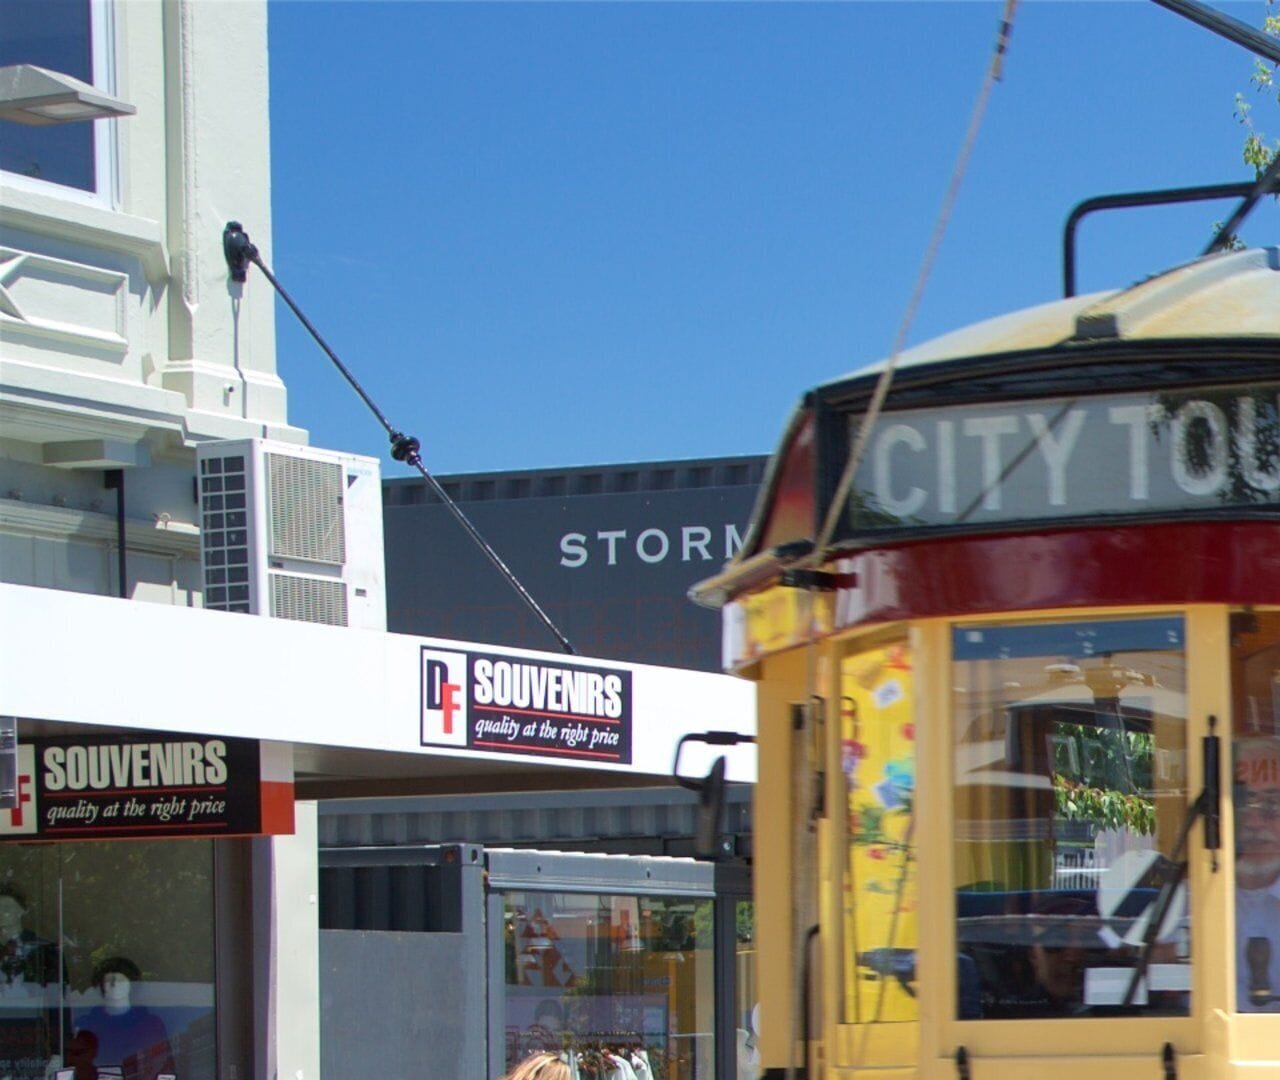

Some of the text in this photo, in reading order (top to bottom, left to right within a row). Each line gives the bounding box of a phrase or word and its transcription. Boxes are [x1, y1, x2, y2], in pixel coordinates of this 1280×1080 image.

[872, 409, 1085, 518] CITY
[474, 659, 622, 718] SOUVENIRS
[475, 716, 619, 749] quality at the right price
[44, 740, 228, 791] SOUVENIRS
[47, 795, 226, 824] quality at the right price
